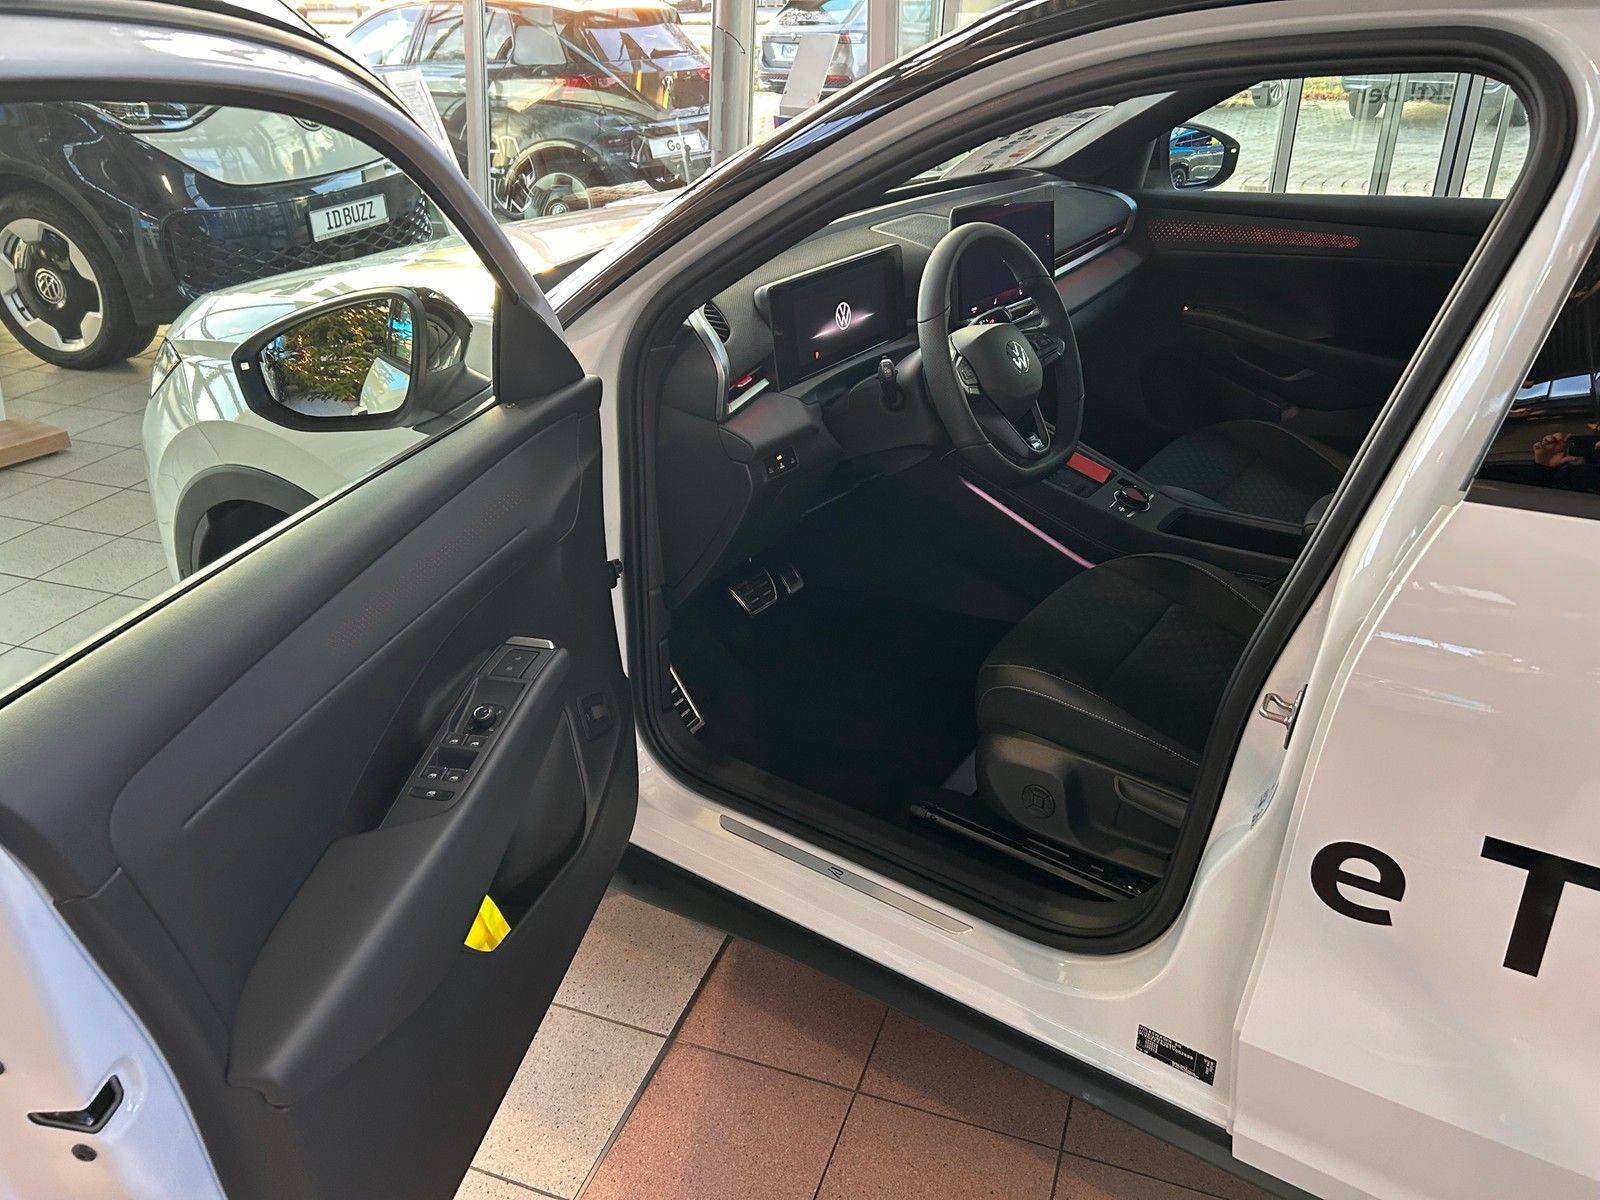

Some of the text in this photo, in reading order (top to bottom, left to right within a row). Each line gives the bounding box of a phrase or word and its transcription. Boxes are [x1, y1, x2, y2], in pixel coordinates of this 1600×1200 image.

[666, 137, 688, 152] Go
[343, 201, 376, 226] BUZZ
[1310, 835, 1600, 978] e T
